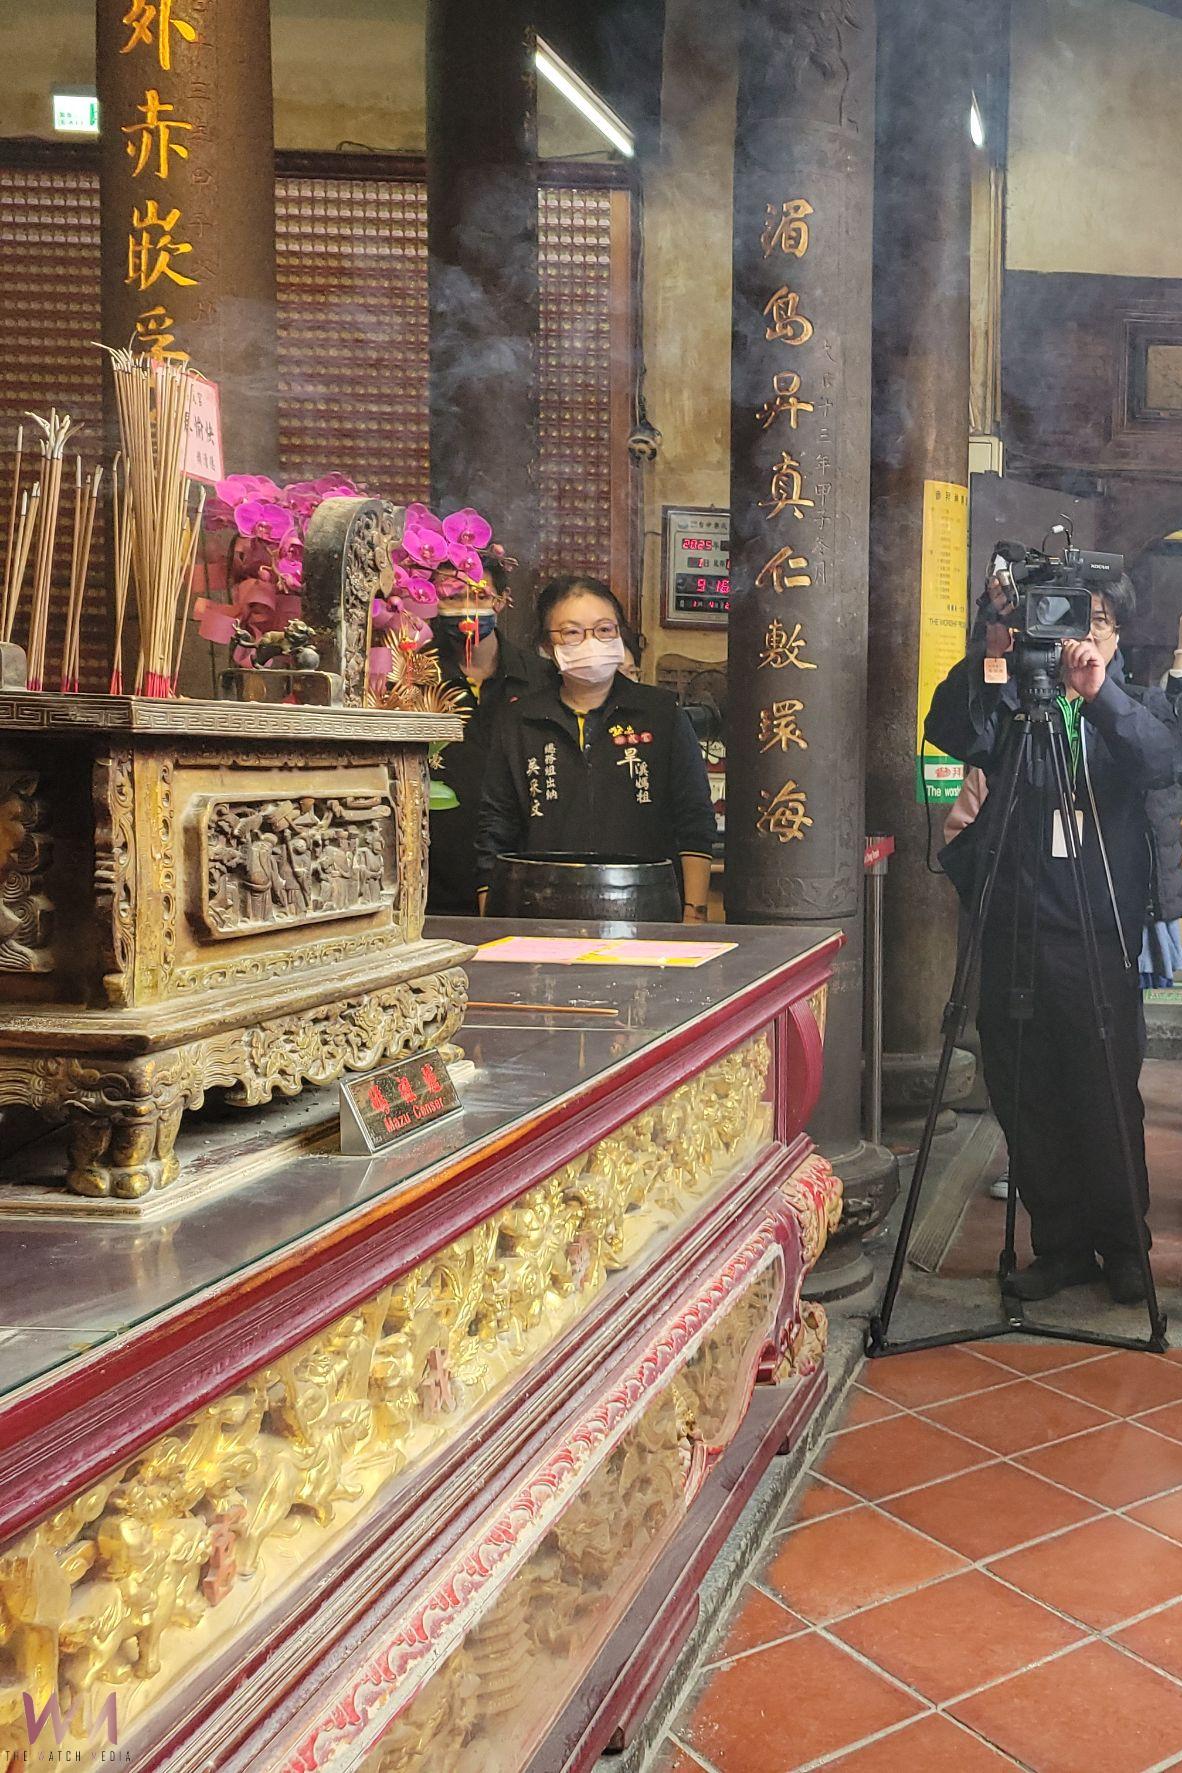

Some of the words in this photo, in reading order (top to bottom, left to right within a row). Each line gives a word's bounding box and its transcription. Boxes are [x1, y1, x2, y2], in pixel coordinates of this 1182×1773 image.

[926, 785, 942, 797] The
[383, 1112, 412, 1134] Mazu
[412, 1096, 446, 1119] Censer
